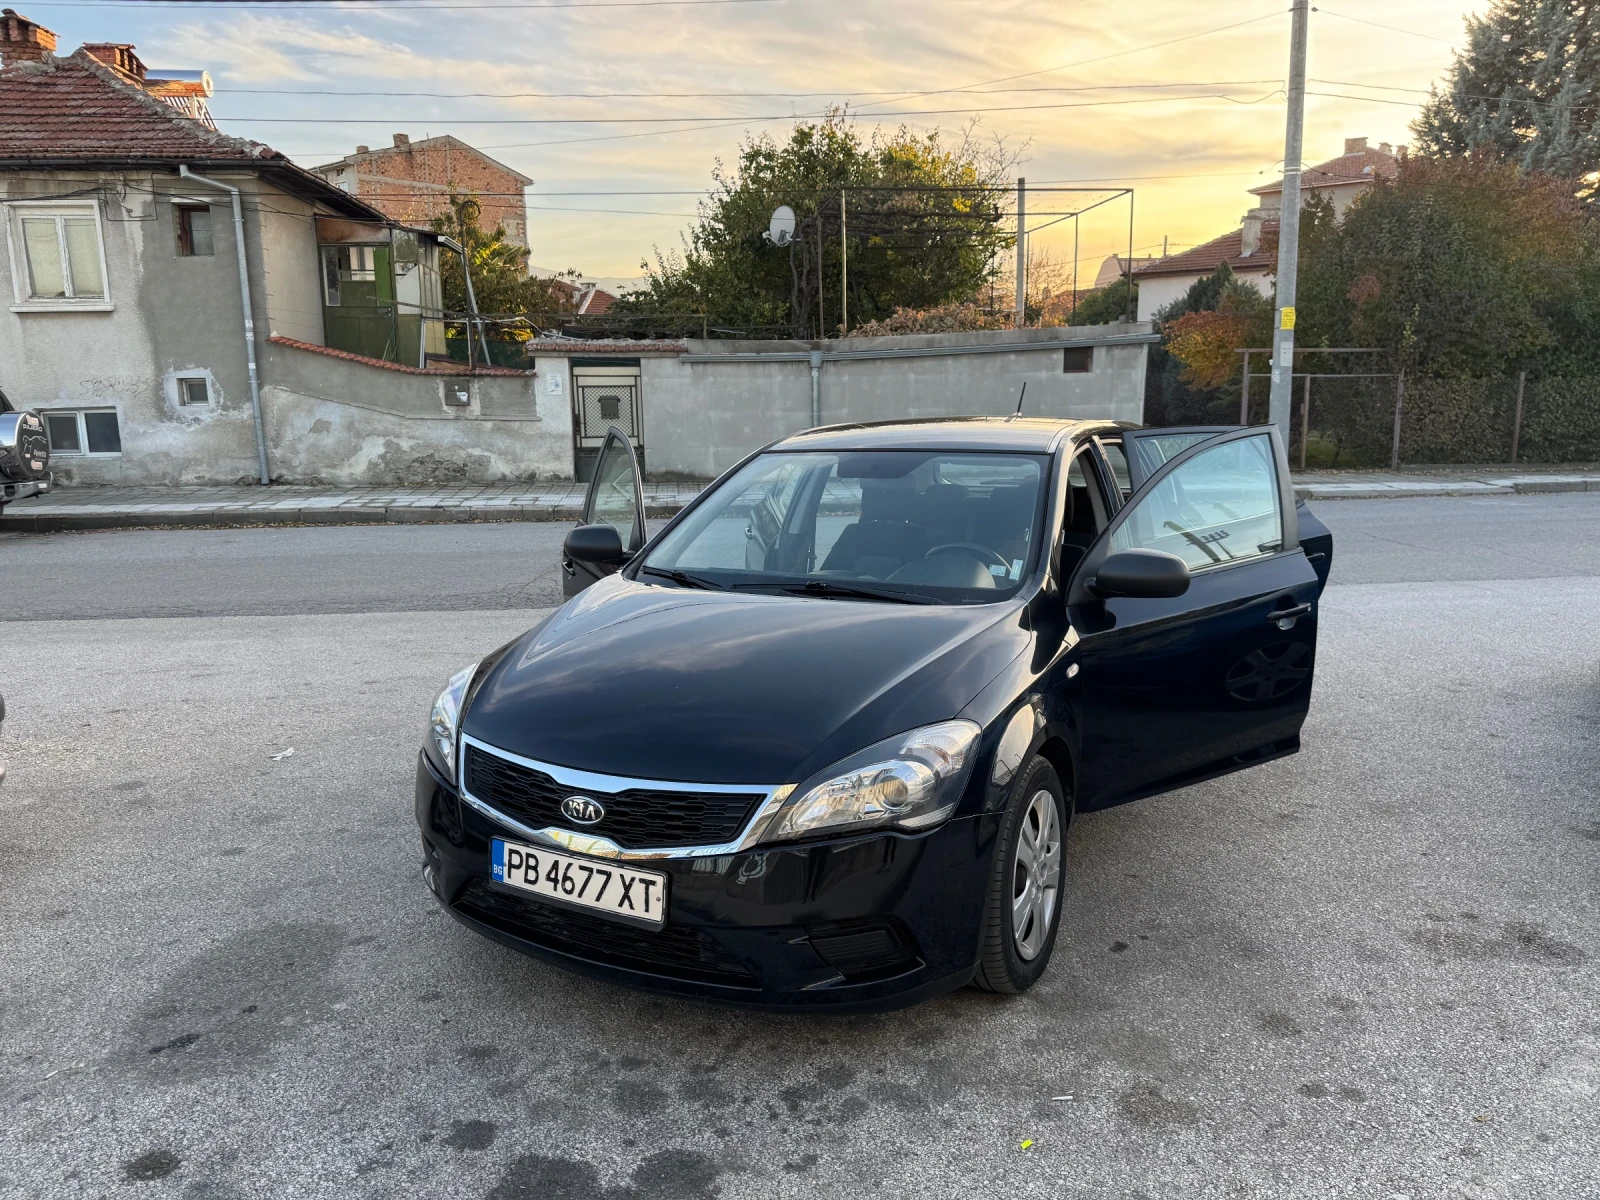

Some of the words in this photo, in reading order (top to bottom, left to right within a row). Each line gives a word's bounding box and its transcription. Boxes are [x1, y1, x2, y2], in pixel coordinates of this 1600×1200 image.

[567, 800, 596, 820] KIA
[493, 865, 503, 876] BG
[507, 848, 540, 886] PB
[545, 859, 612, 903] 4677
[618, 873, 657, 913] XT
